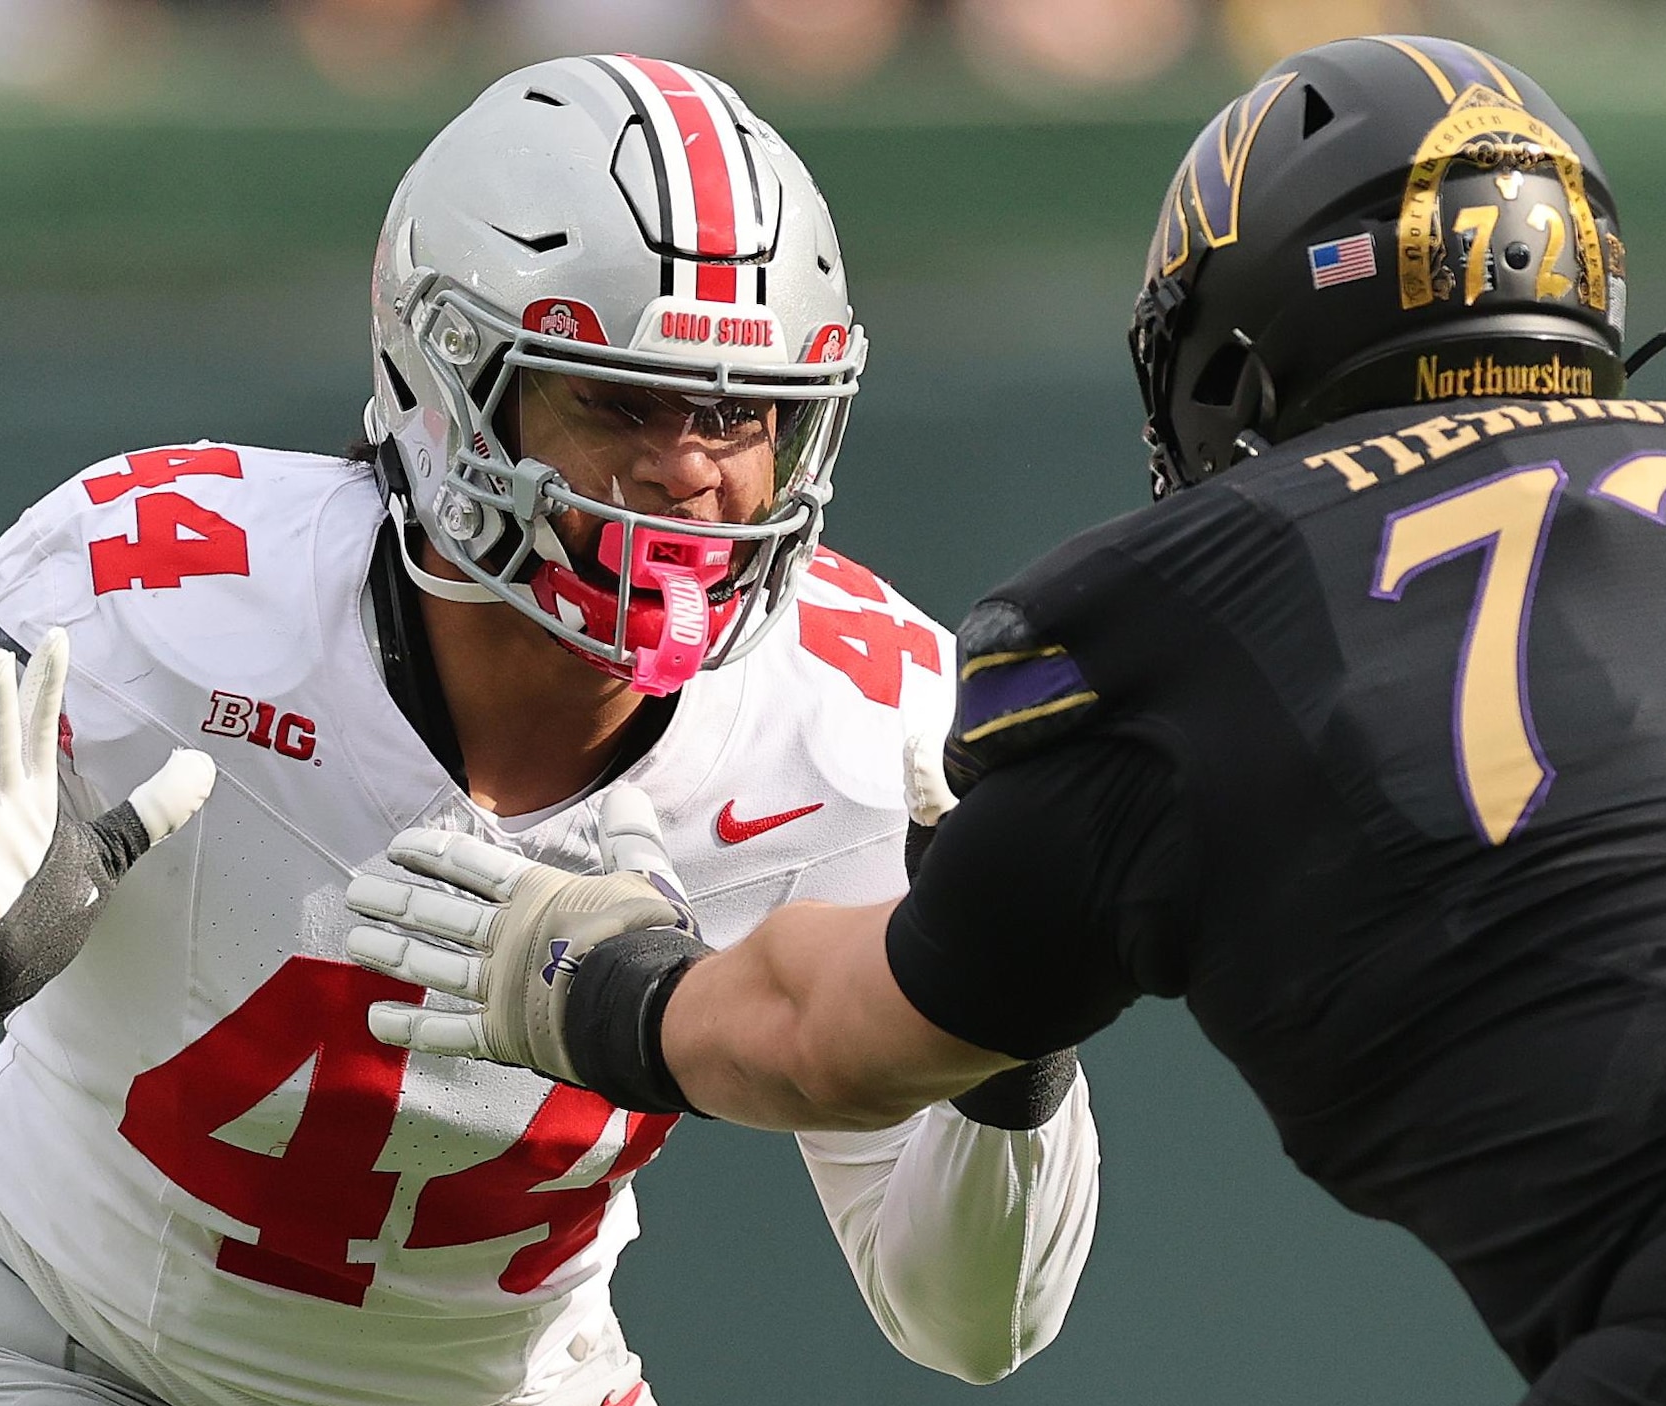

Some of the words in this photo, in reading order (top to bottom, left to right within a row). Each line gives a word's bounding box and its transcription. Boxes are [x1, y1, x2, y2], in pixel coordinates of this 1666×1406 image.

[1452, 203, 1574, 306] 72
[661, 311, 712, 342] OHIO
[718, 316, 774, 348] STATE
[1414, 353, 1593, 401] Northwestern
[82, 447, 250, 596] 44
[118, 954, 685, 1308] 44
